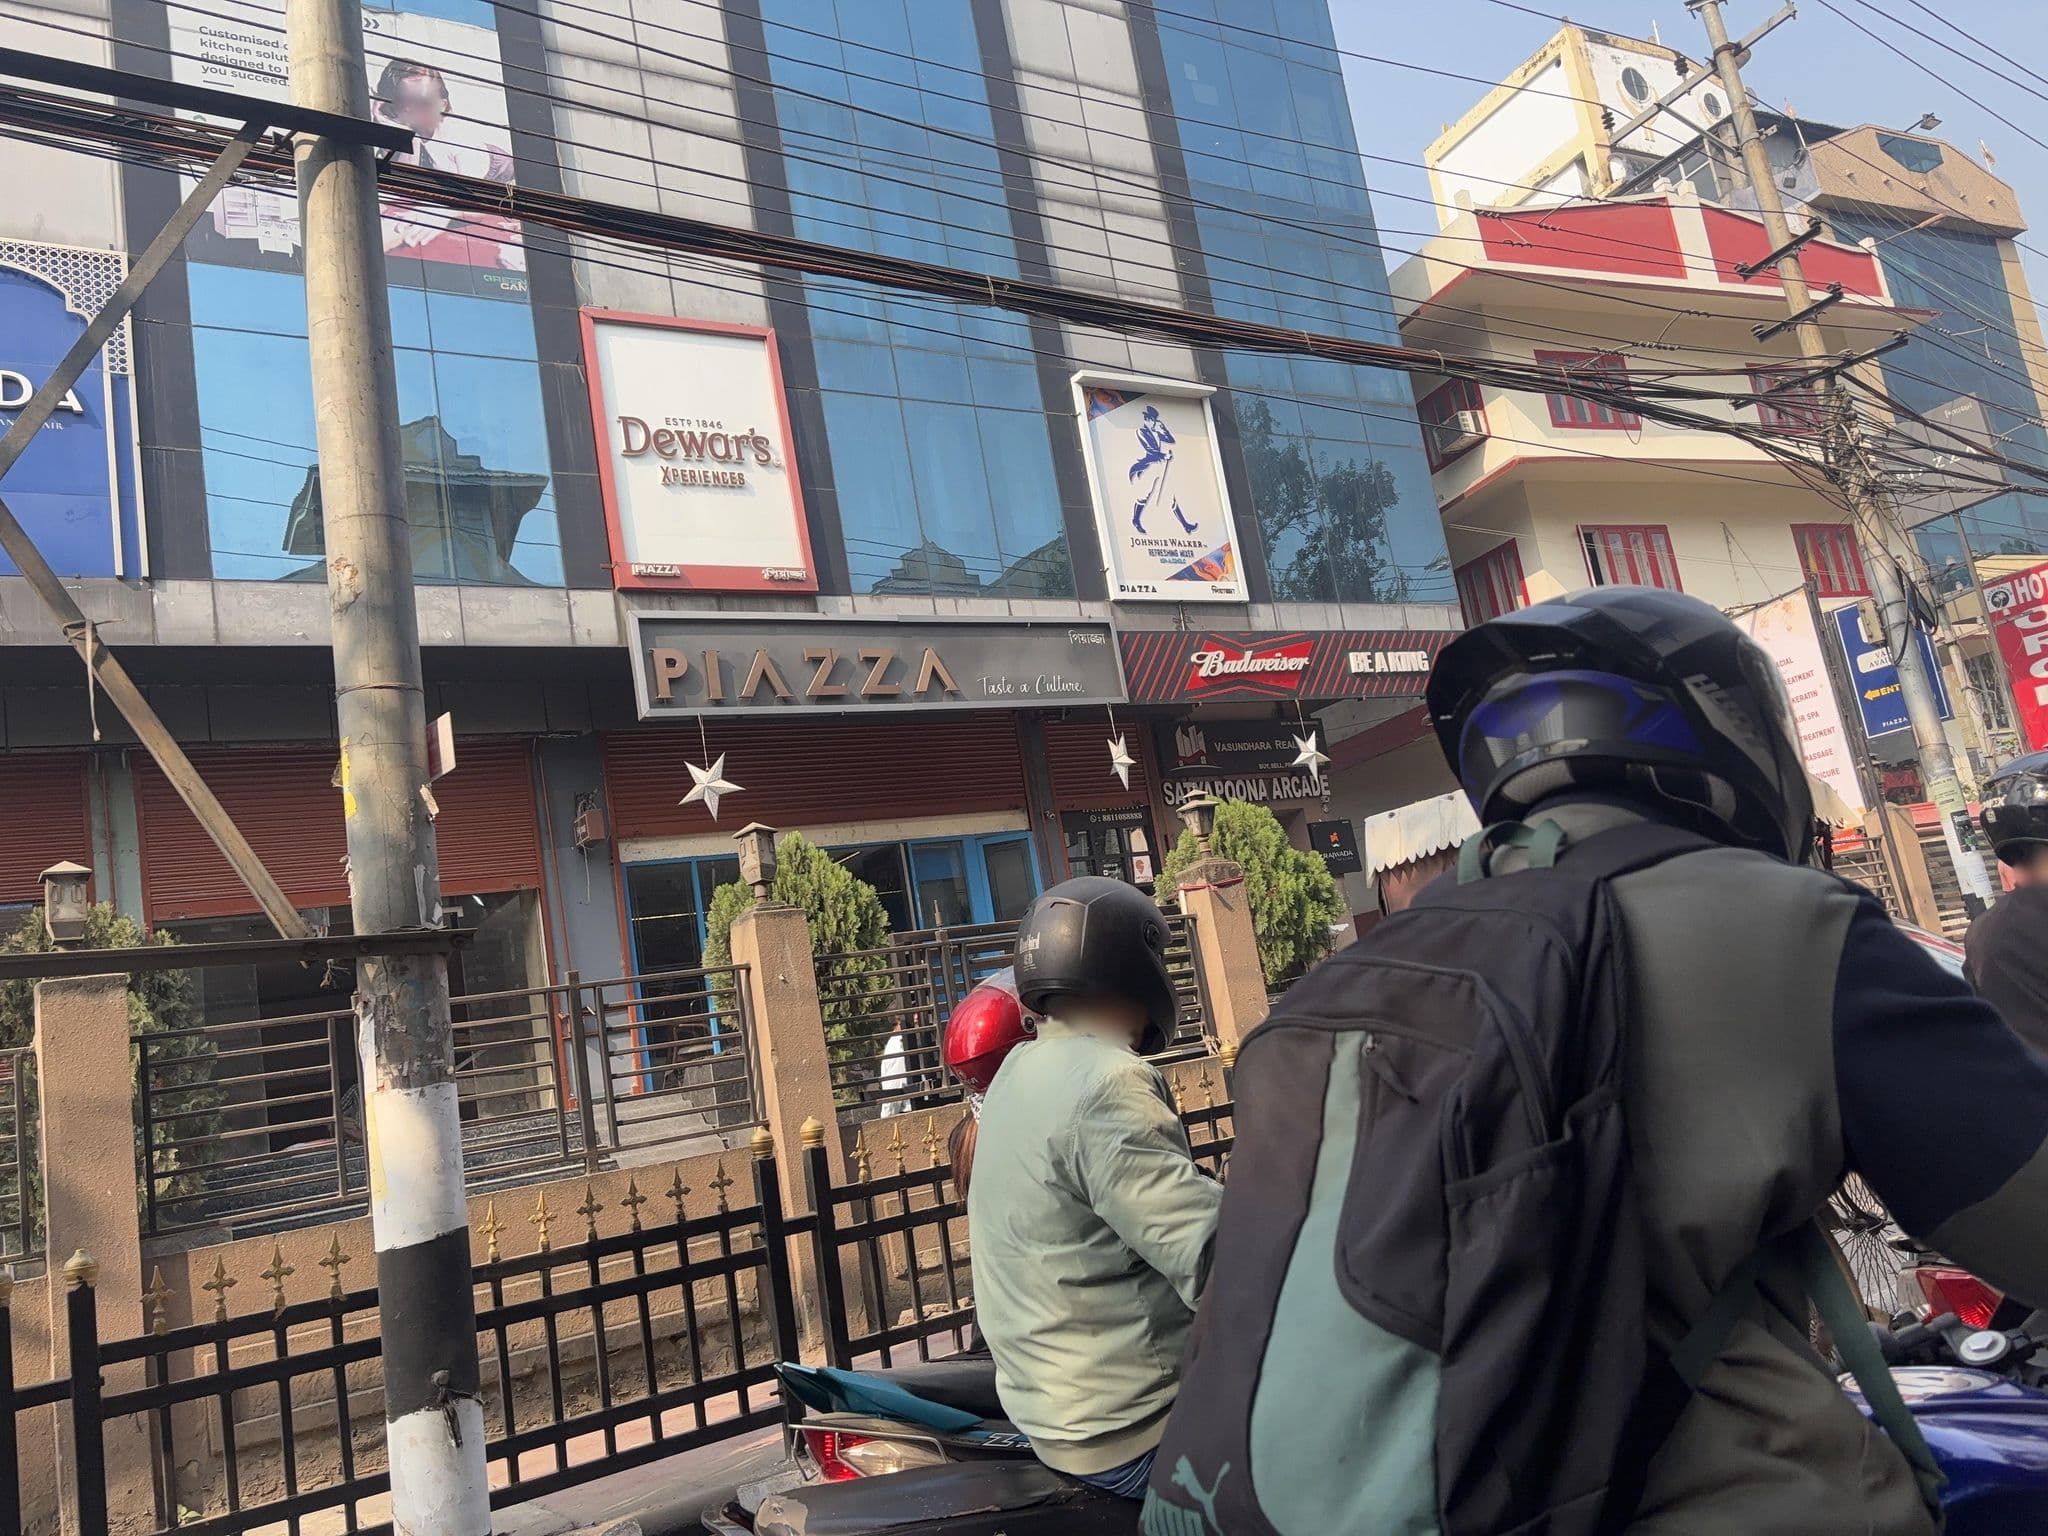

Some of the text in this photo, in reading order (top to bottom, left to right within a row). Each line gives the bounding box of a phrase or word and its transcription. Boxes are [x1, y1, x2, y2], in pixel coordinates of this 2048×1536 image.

[199, 25, 280, 49] Customised
[200, 38, 252, 56] kitchen
[201, 51, 282, 73] designed to
[201, 65, 290, 87] you succeed.
[696, 419, 723, 430] 1846
[616, 415, 772, 466] Dewar's
[660, 466, 746, 488] XPERIENCES
[1130, 537, 1203, 549] JOHNNIE WALKER
[1148, 548, 1179, 558] REFRESHING
[631, 563, 681, 577] PIAZZA
[1120, 584, 1158, 593] PIAZZA
[1190, 650, 1310, 678] Budweiser
[1349, 650, 1430, 674] BE A KING
[649, 647, 961, 701] PIAZZA
[977, 674, 1085, 696] Taste a Culture.
[1807, 710, 1820, 720] SPA
[1882, 716, 1909, 728] PIAZZA
[1800, 726, 1836, 743] TREATMENT
[1214, 739, 1272, 752] VASUNDHARA
[1272, 774, 1331, 800] ARCADE
